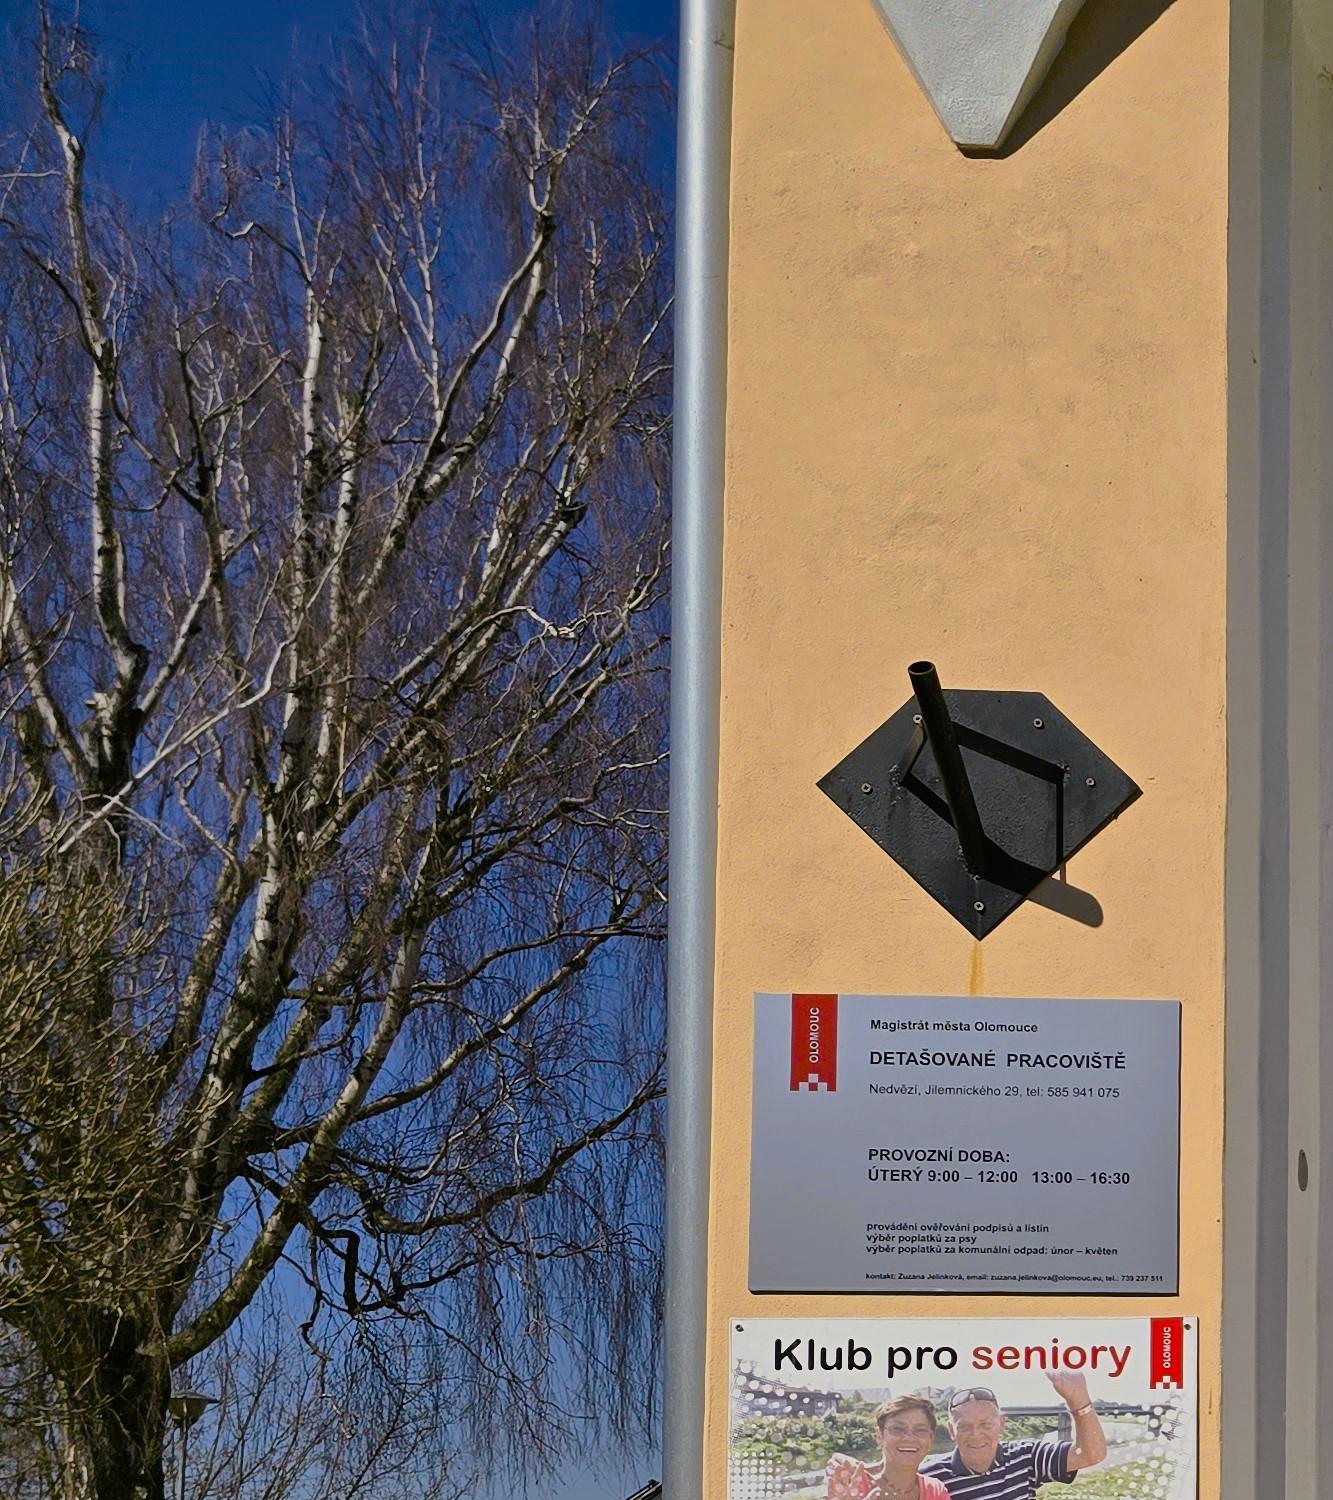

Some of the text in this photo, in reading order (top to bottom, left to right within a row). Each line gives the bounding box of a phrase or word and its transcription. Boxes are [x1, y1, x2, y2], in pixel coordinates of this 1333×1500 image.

[870, 1019, 1038, 1033] Magistrát města Olomouce
[809, 1007, 820, 1064] OLOMOUC
[870, 1048, 1126, 1069] DETAŠOVANÉ PRACOVIŠTĚ
[869, 1084, 1120, 1098] Nedvězí, Jilemnického 29, tel: 585 941 075
[868, 1147, 1010, 1163] PROVOZNÍ DOBA:
[868, 1166, 924, 1182] ÚTERÝ
[927, 1170, 960, 1183] 9:00
[977, 1170, 1018, 1183] 12:00
[1032, 1171, 1073, 1184] 13:00
[1090, 1172, 1130, 1184] 16:30
[866, 1223, 918, 1232] provádění
[920, 1223, 970, 1232] ověřování
[973, 1223, 1013, 1233] podpisů
[1025, 1224, 1049, 1233] listin
[866, 1233, 895, 1243] výběr
[898, 1234, 942, 1243] poplatků
[959, 1236, 977, 1244] psy
[866, 1244, 895, 1254] výběr
[898, 1245, 942, 1254] poplatků
[959, 1245, 1011, 1254] komunální
[1013, 1246, 1048, 1256] odpad:
[1051, 1246, 1075, 1255] únor
[1085, 1247, 1118, 1255] květen
[1163, 1326, 1172, 1368] OLOMOUC
[773, 1338, 1131, 1378] Klub pro seniory
